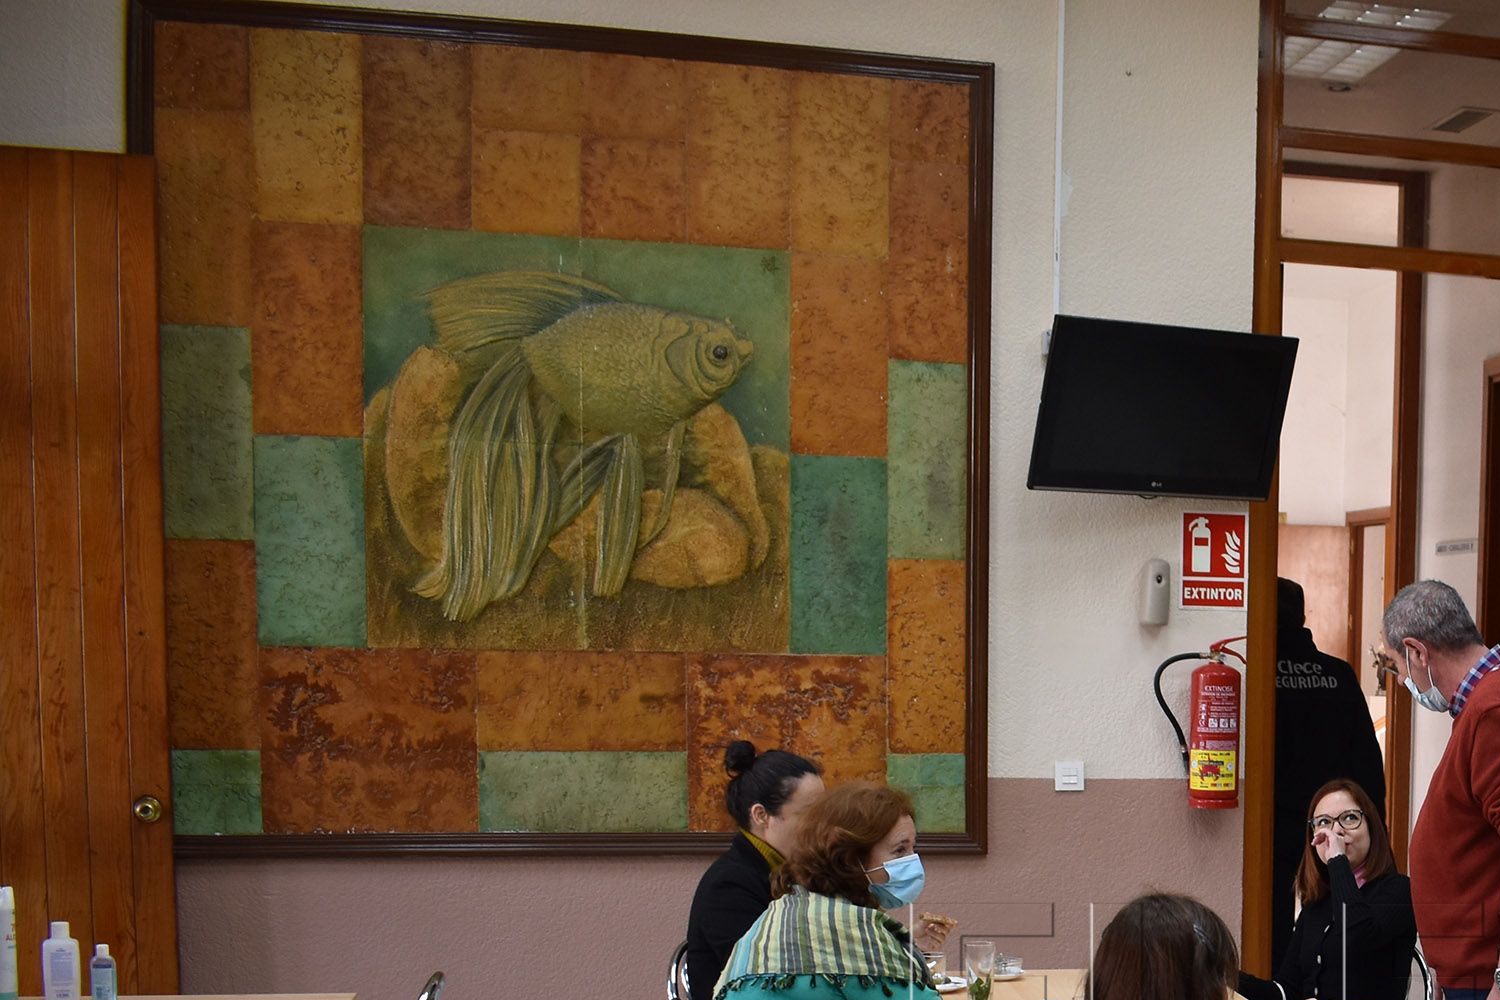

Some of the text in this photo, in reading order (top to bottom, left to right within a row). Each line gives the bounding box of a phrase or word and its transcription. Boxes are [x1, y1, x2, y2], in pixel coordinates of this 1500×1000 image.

[1184, 587, 1243, 600] EXTINTOR
[1278, 660, 1322, 674] Clece
[1275, 675, 1338, 689] EGURIDAD
